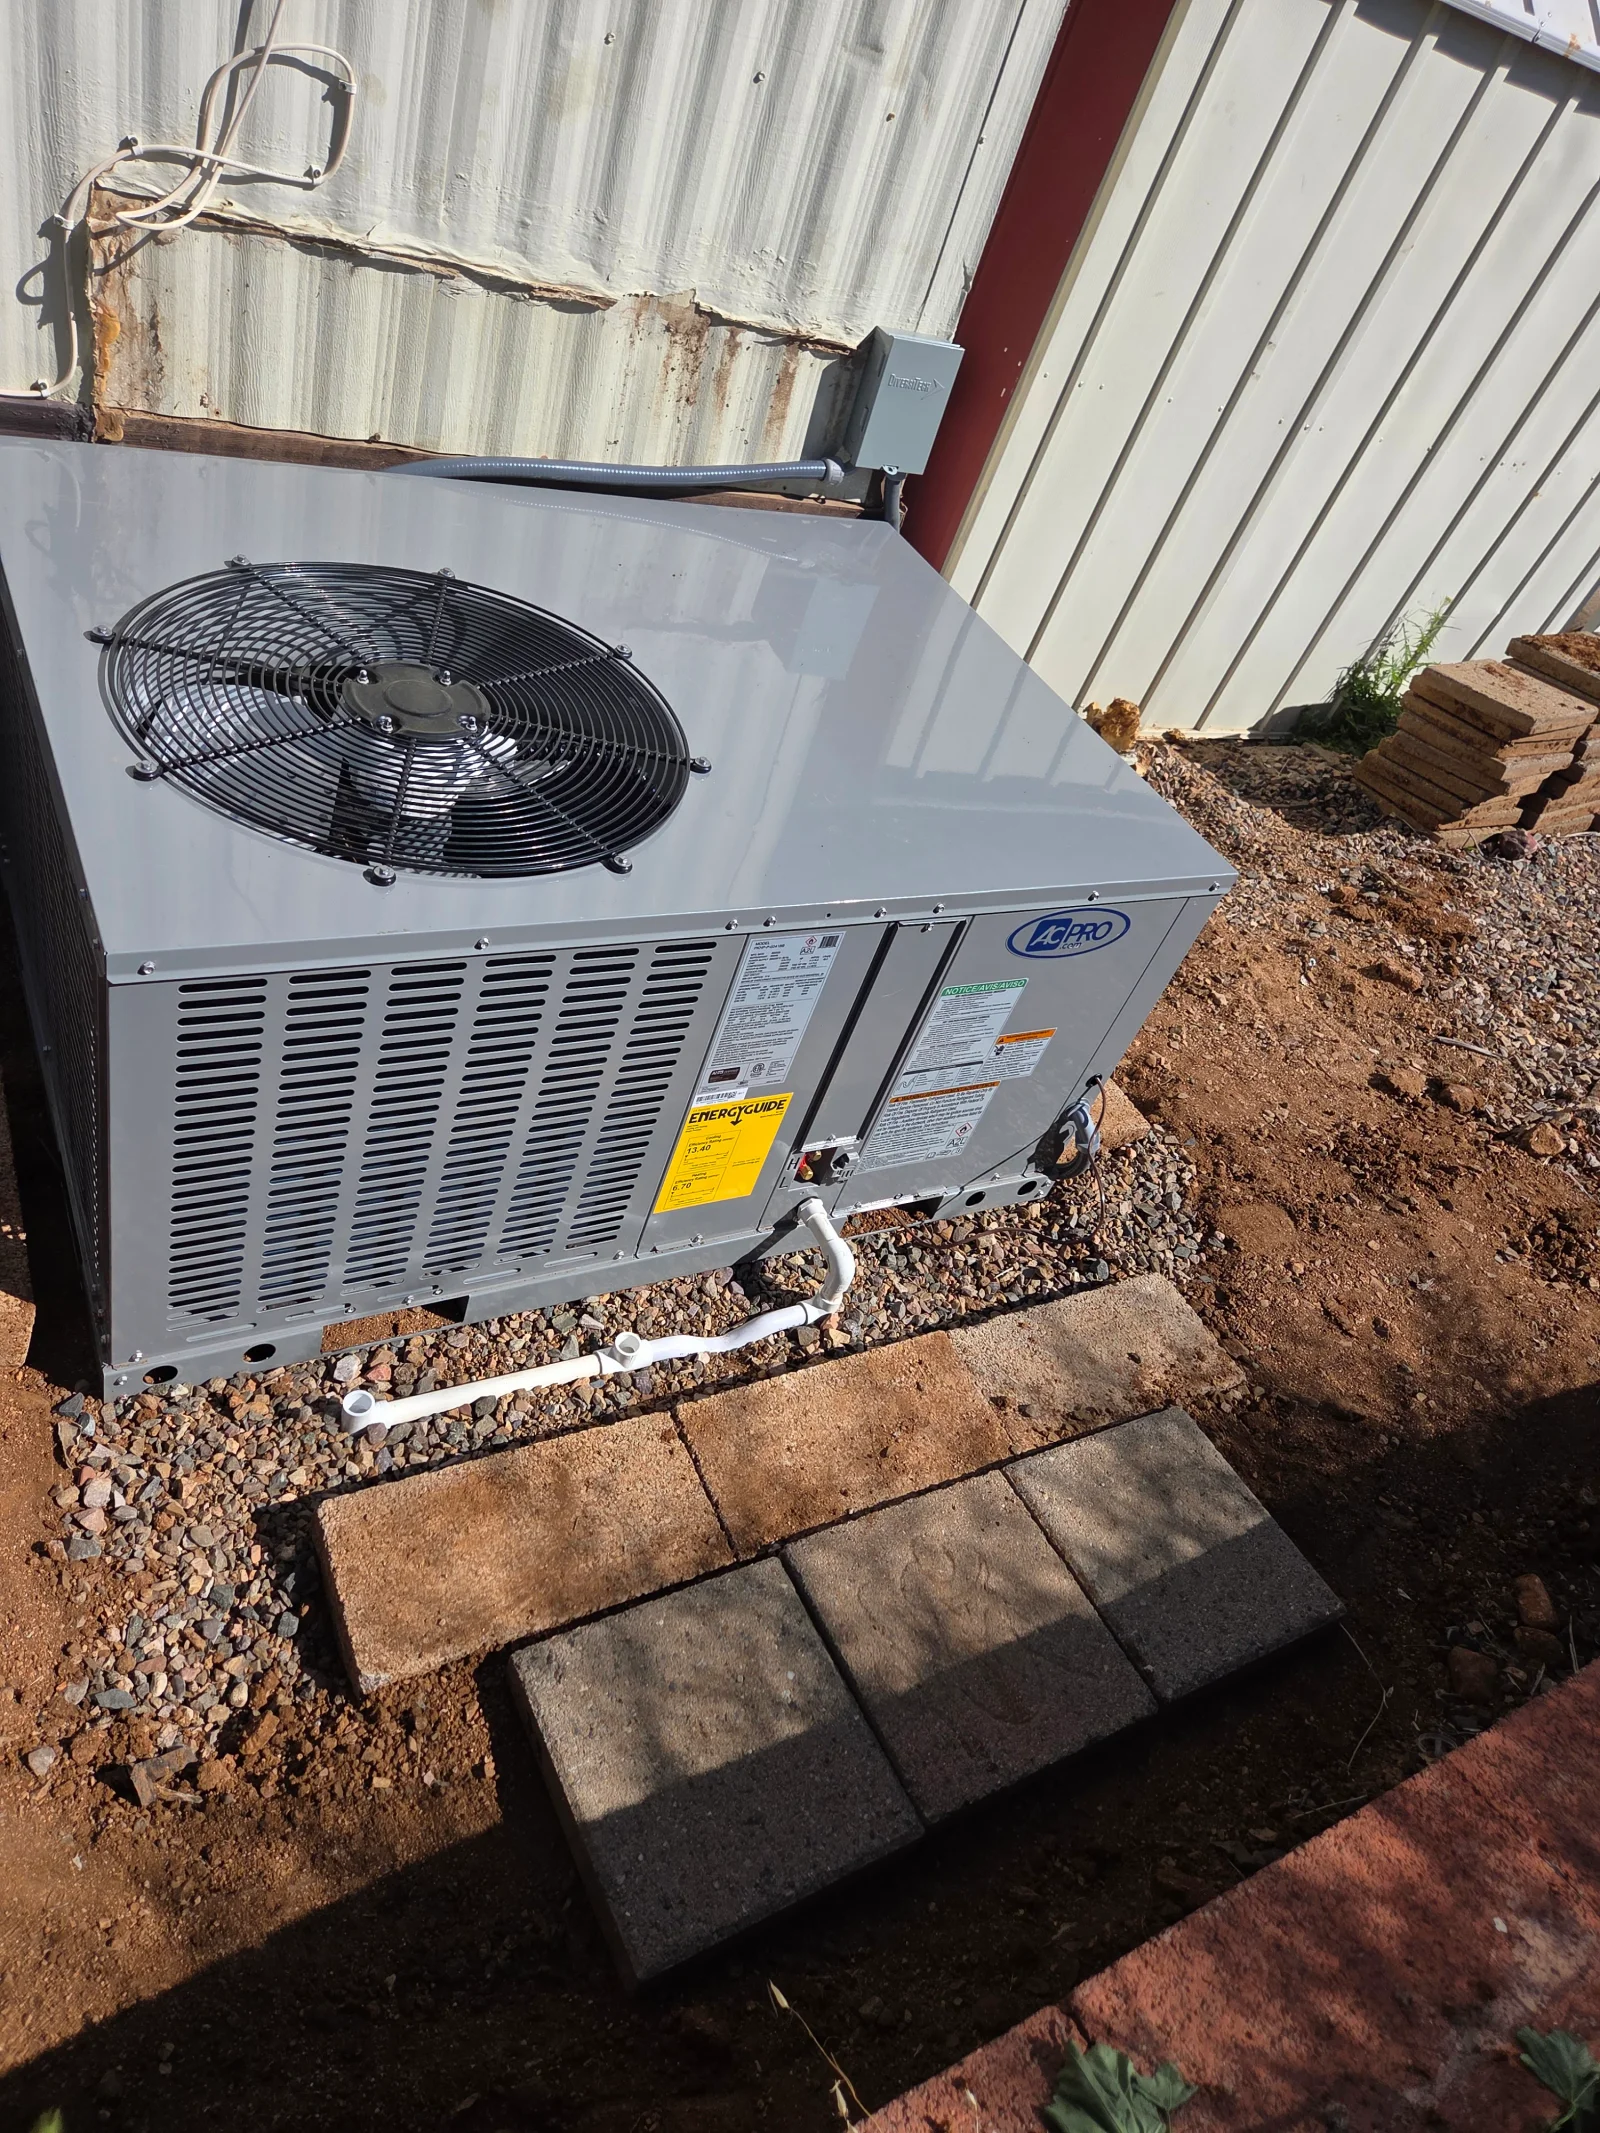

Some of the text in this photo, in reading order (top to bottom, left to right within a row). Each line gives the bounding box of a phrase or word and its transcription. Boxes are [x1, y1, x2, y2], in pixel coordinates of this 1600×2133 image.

[689, 1099, 787, 1126] ENERGYGUIDE
[687, 1145, 711, 1154] 13.40
[787, 1158, 799, 1171] H
[672, 1182, 691, 1191] 6.70
[779, 1177, 788, 1188] L
